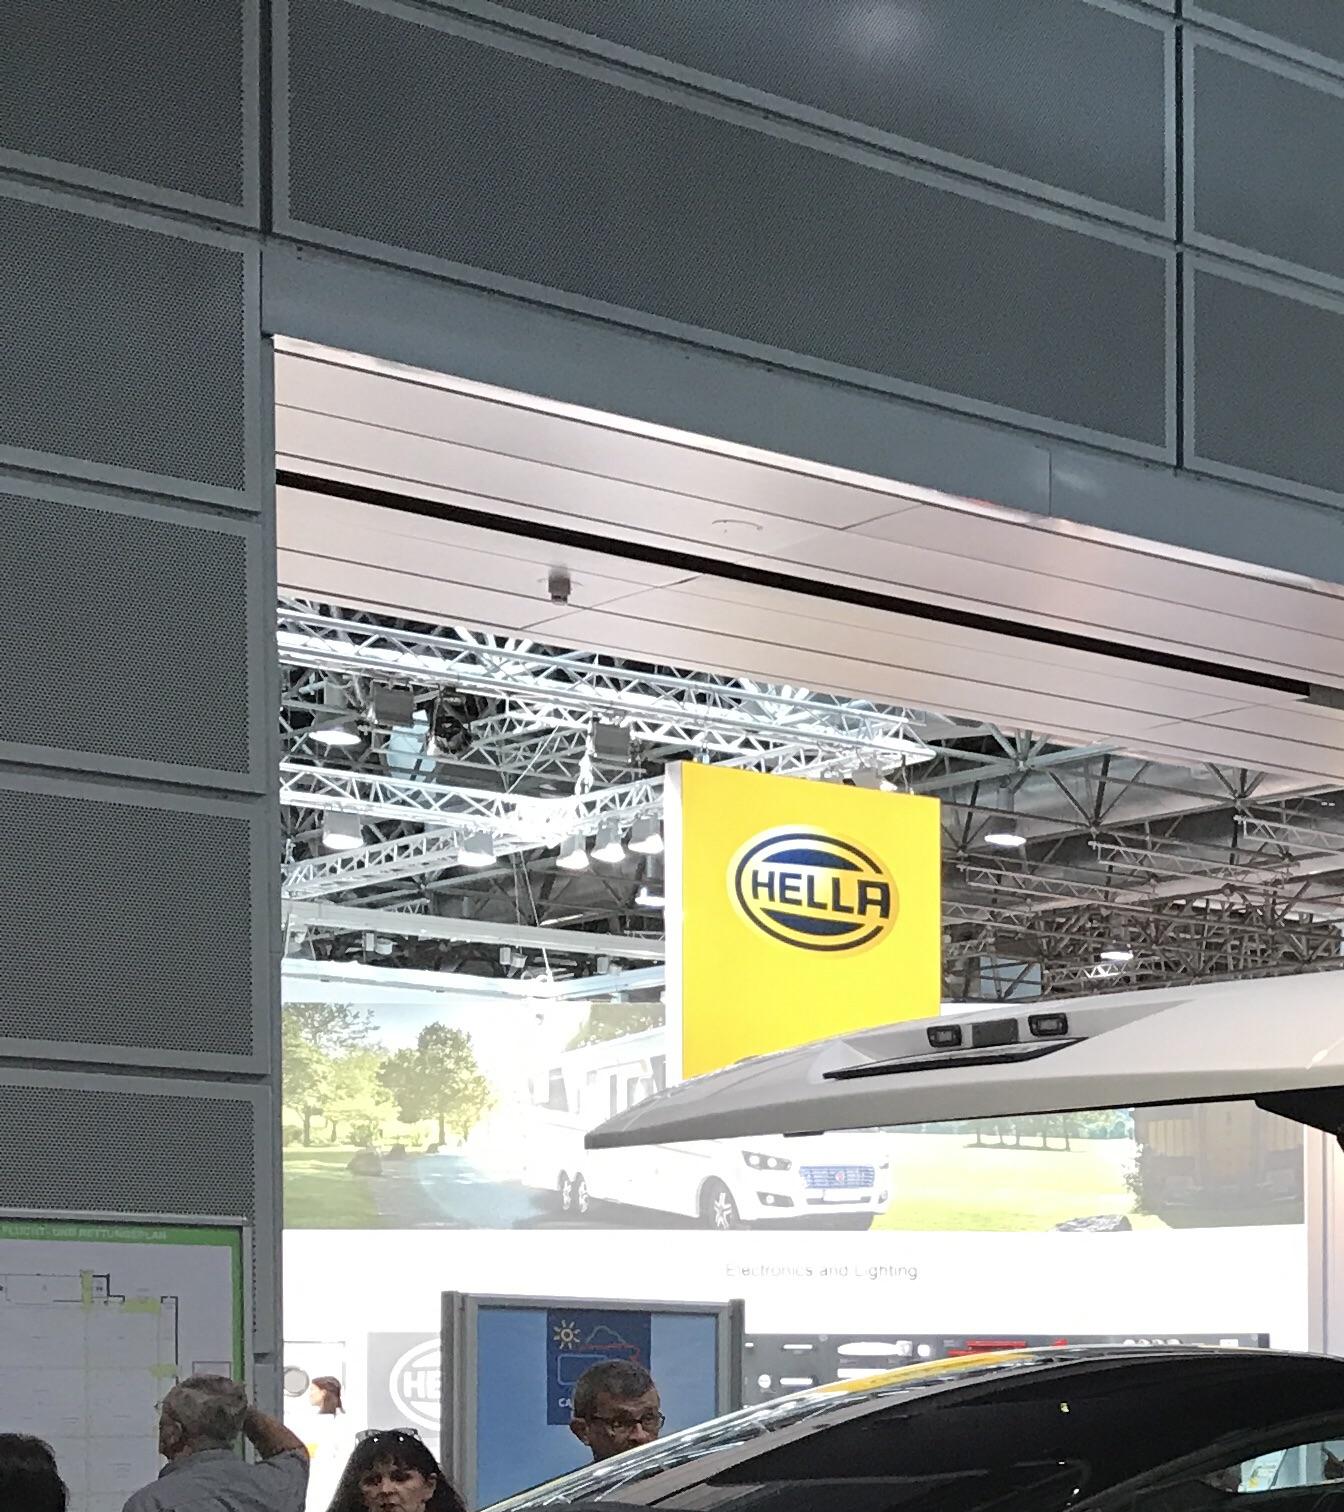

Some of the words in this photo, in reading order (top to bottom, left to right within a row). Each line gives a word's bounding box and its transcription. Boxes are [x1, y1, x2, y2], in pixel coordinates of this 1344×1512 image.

[751, 869, 891, 919] HELLA
[726, 1263, 813, 1278] Electronics
[819, 1263, 848, 1278] and
[855, 1263, 918, 1281] Lighting
